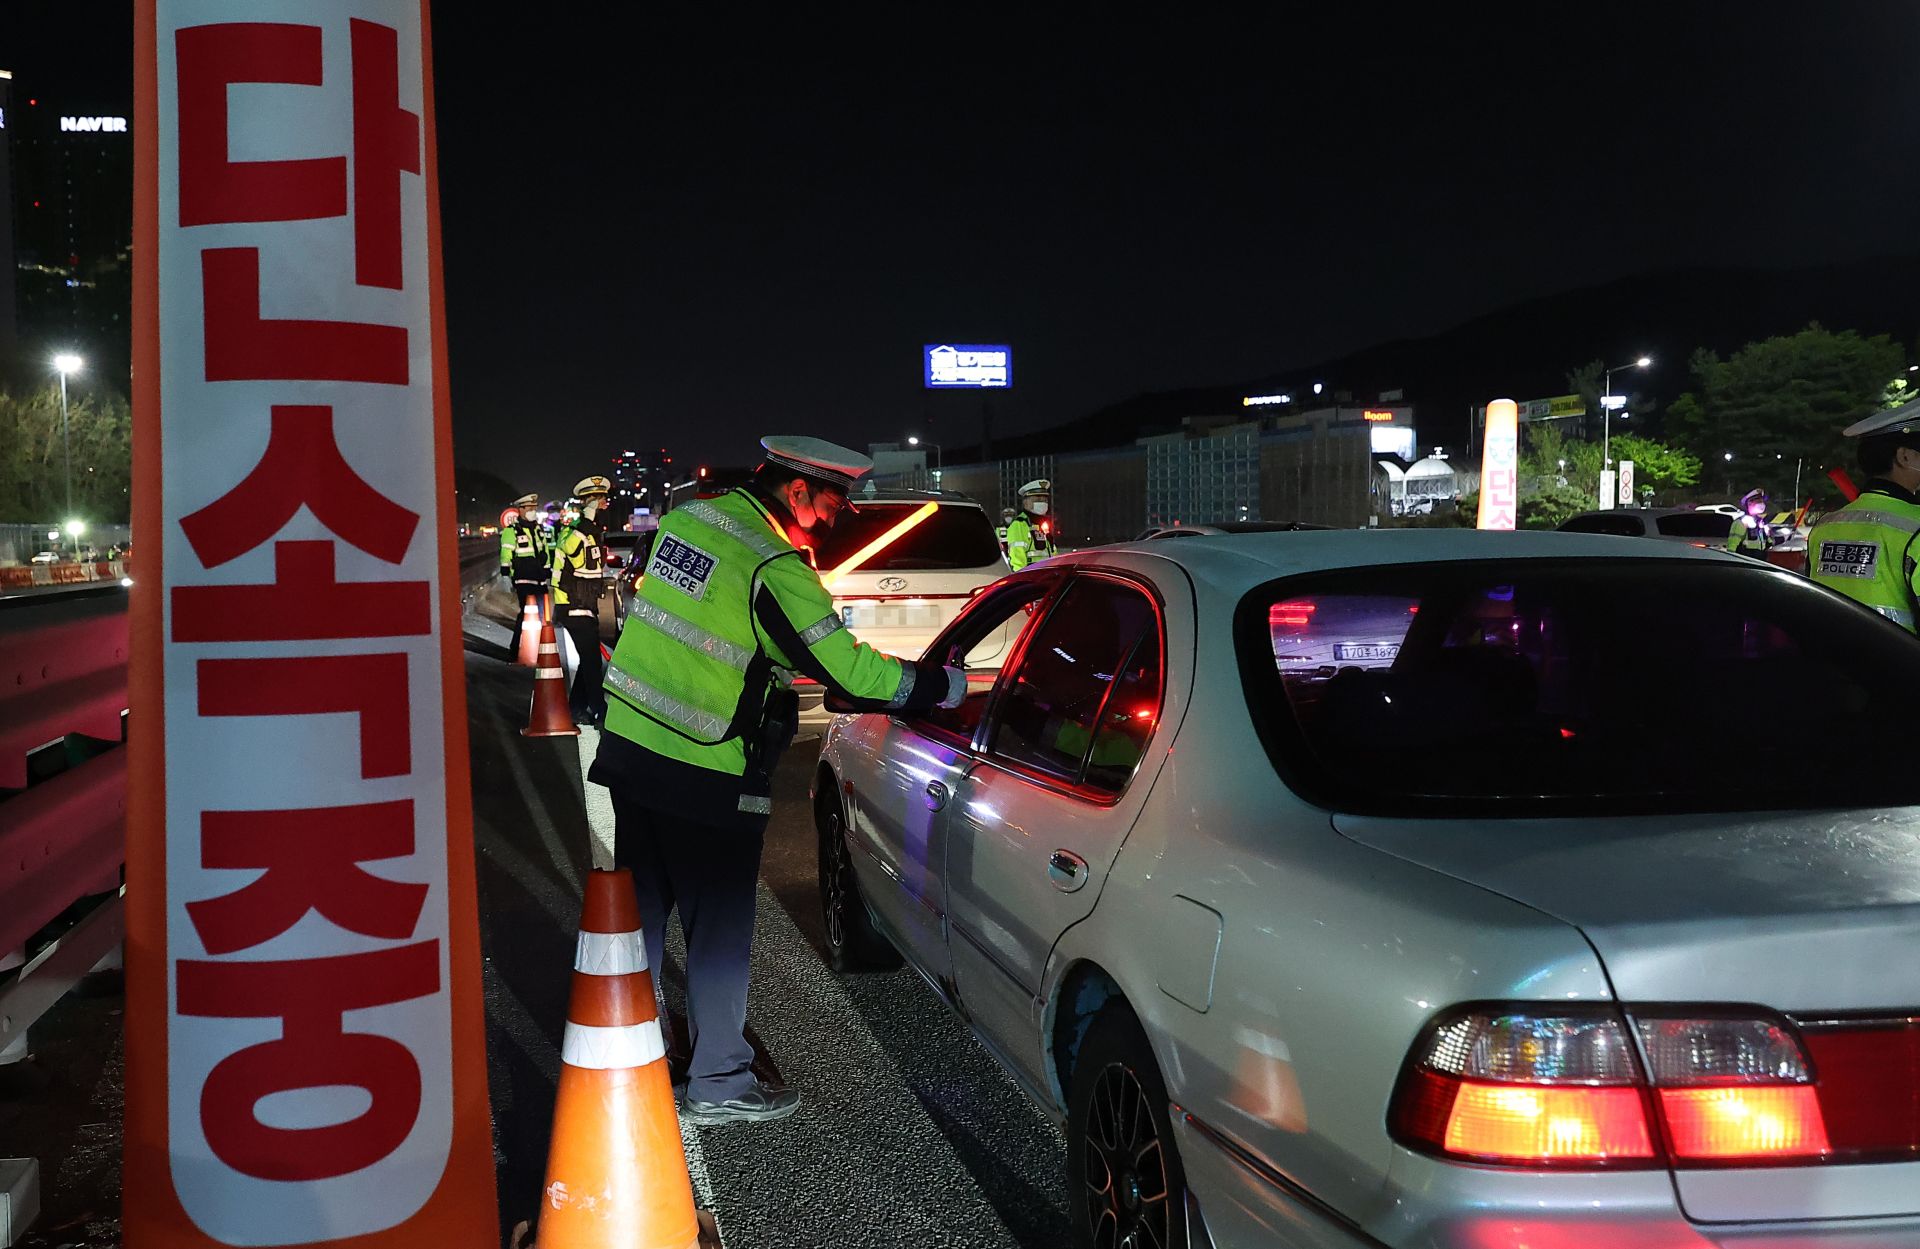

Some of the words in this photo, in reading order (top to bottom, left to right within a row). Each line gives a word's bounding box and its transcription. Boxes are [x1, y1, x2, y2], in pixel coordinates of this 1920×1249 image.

[60, 117, 127, 132] NAVER
[660, 540, 710, 579] 교통경찰
[1824, 545, 1872, 563] 교통경찰
[653, 561, 698, 593] POLICE
[1822, 564, 1867, 575] POLICE
[171, 17, 441, 1182] 단속중
